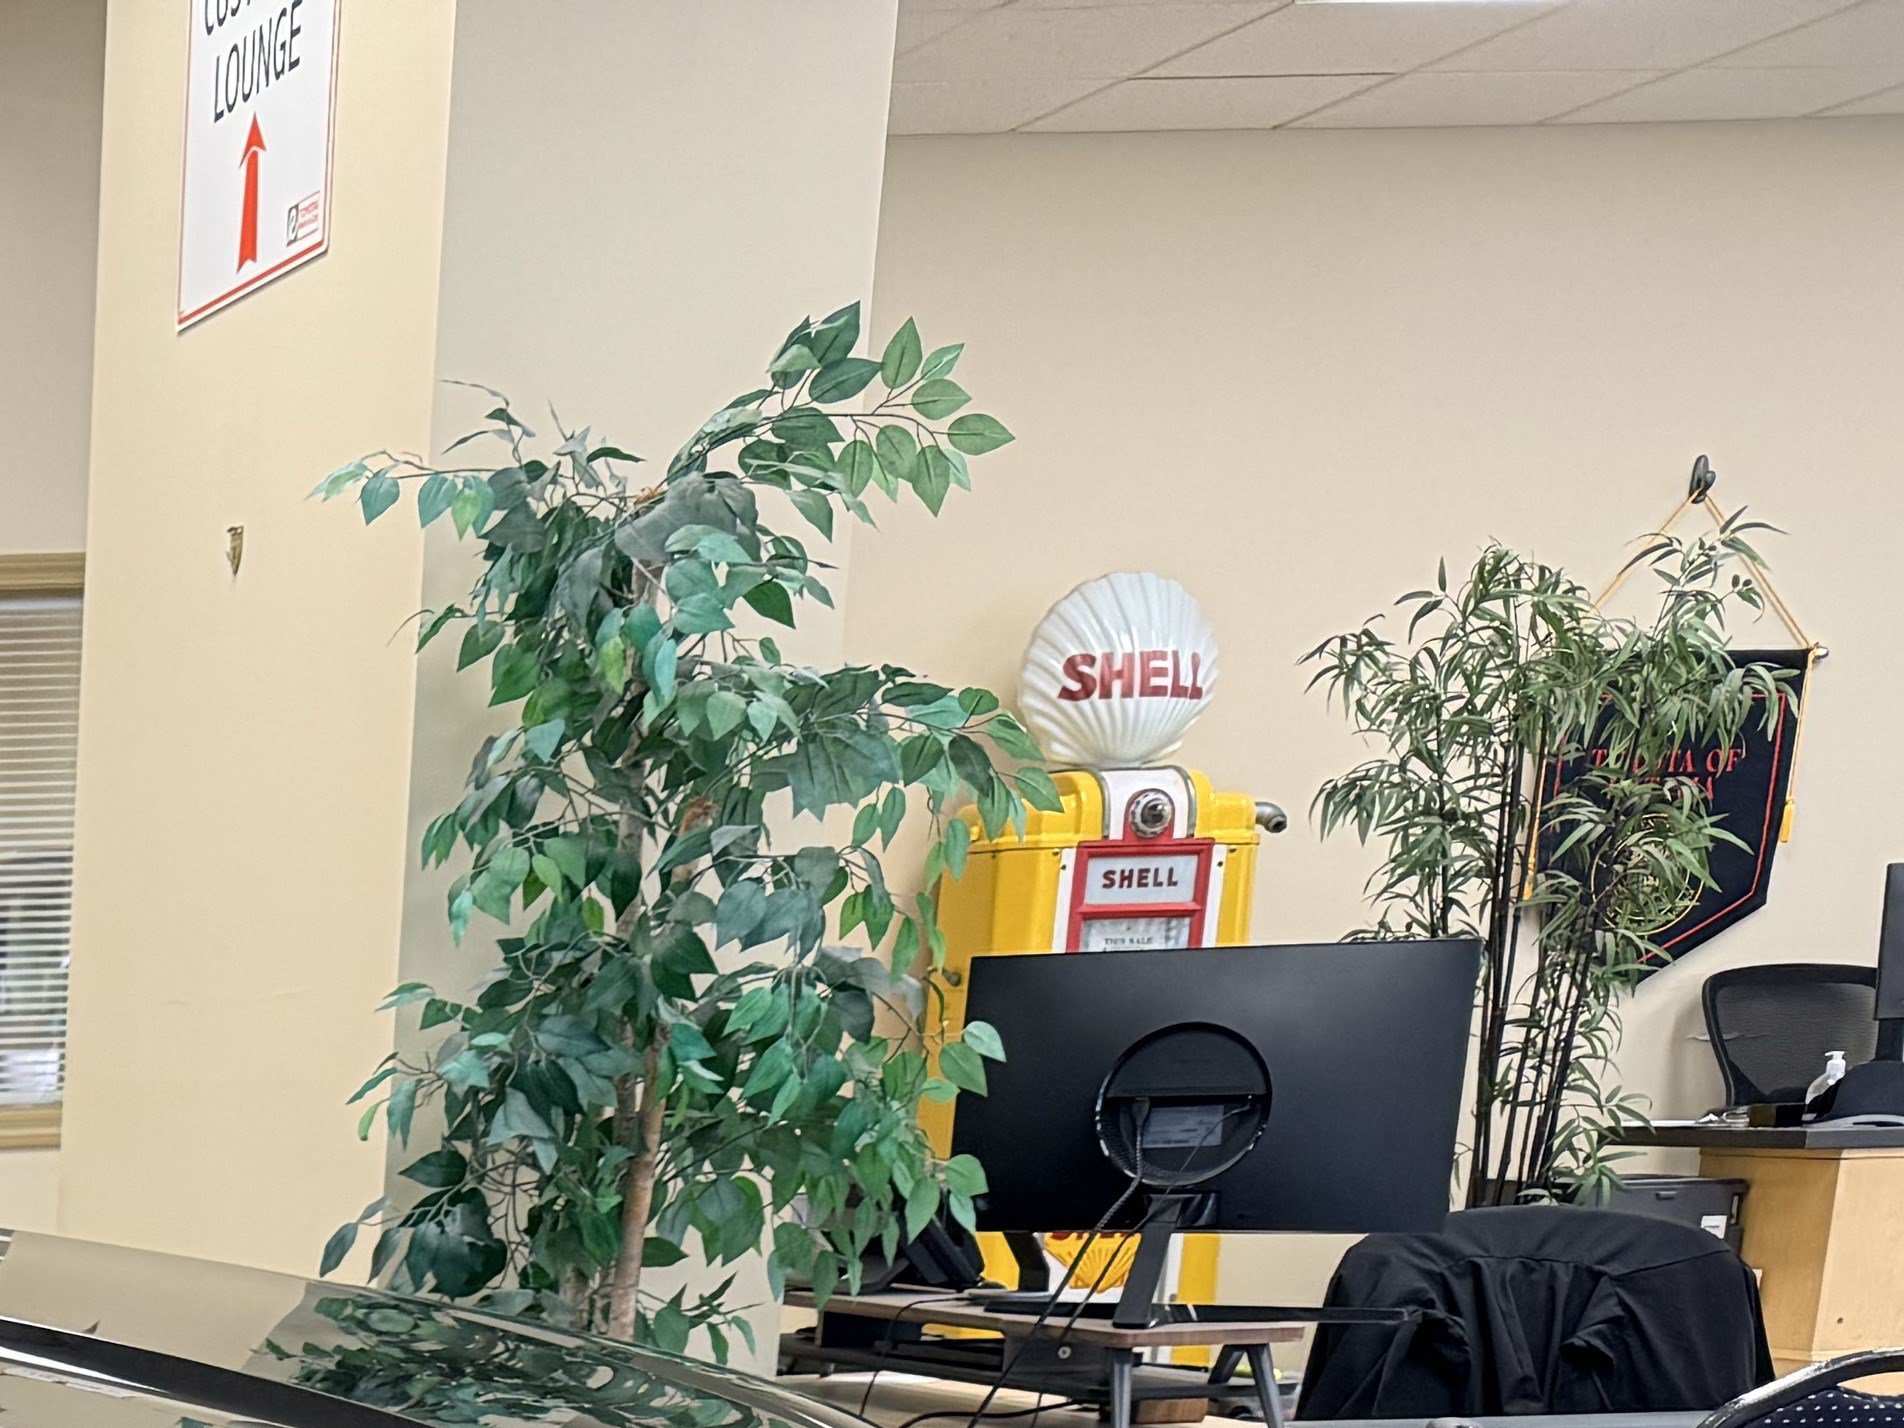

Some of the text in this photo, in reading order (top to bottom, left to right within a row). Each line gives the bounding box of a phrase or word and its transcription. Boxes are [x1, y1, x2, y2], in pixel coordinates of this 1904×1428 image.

[213, 7, 302, 123] LOUNGE
[1058, 650, 1203, 701] SHELL
[1102, 867, 1179, 889] SHELL
